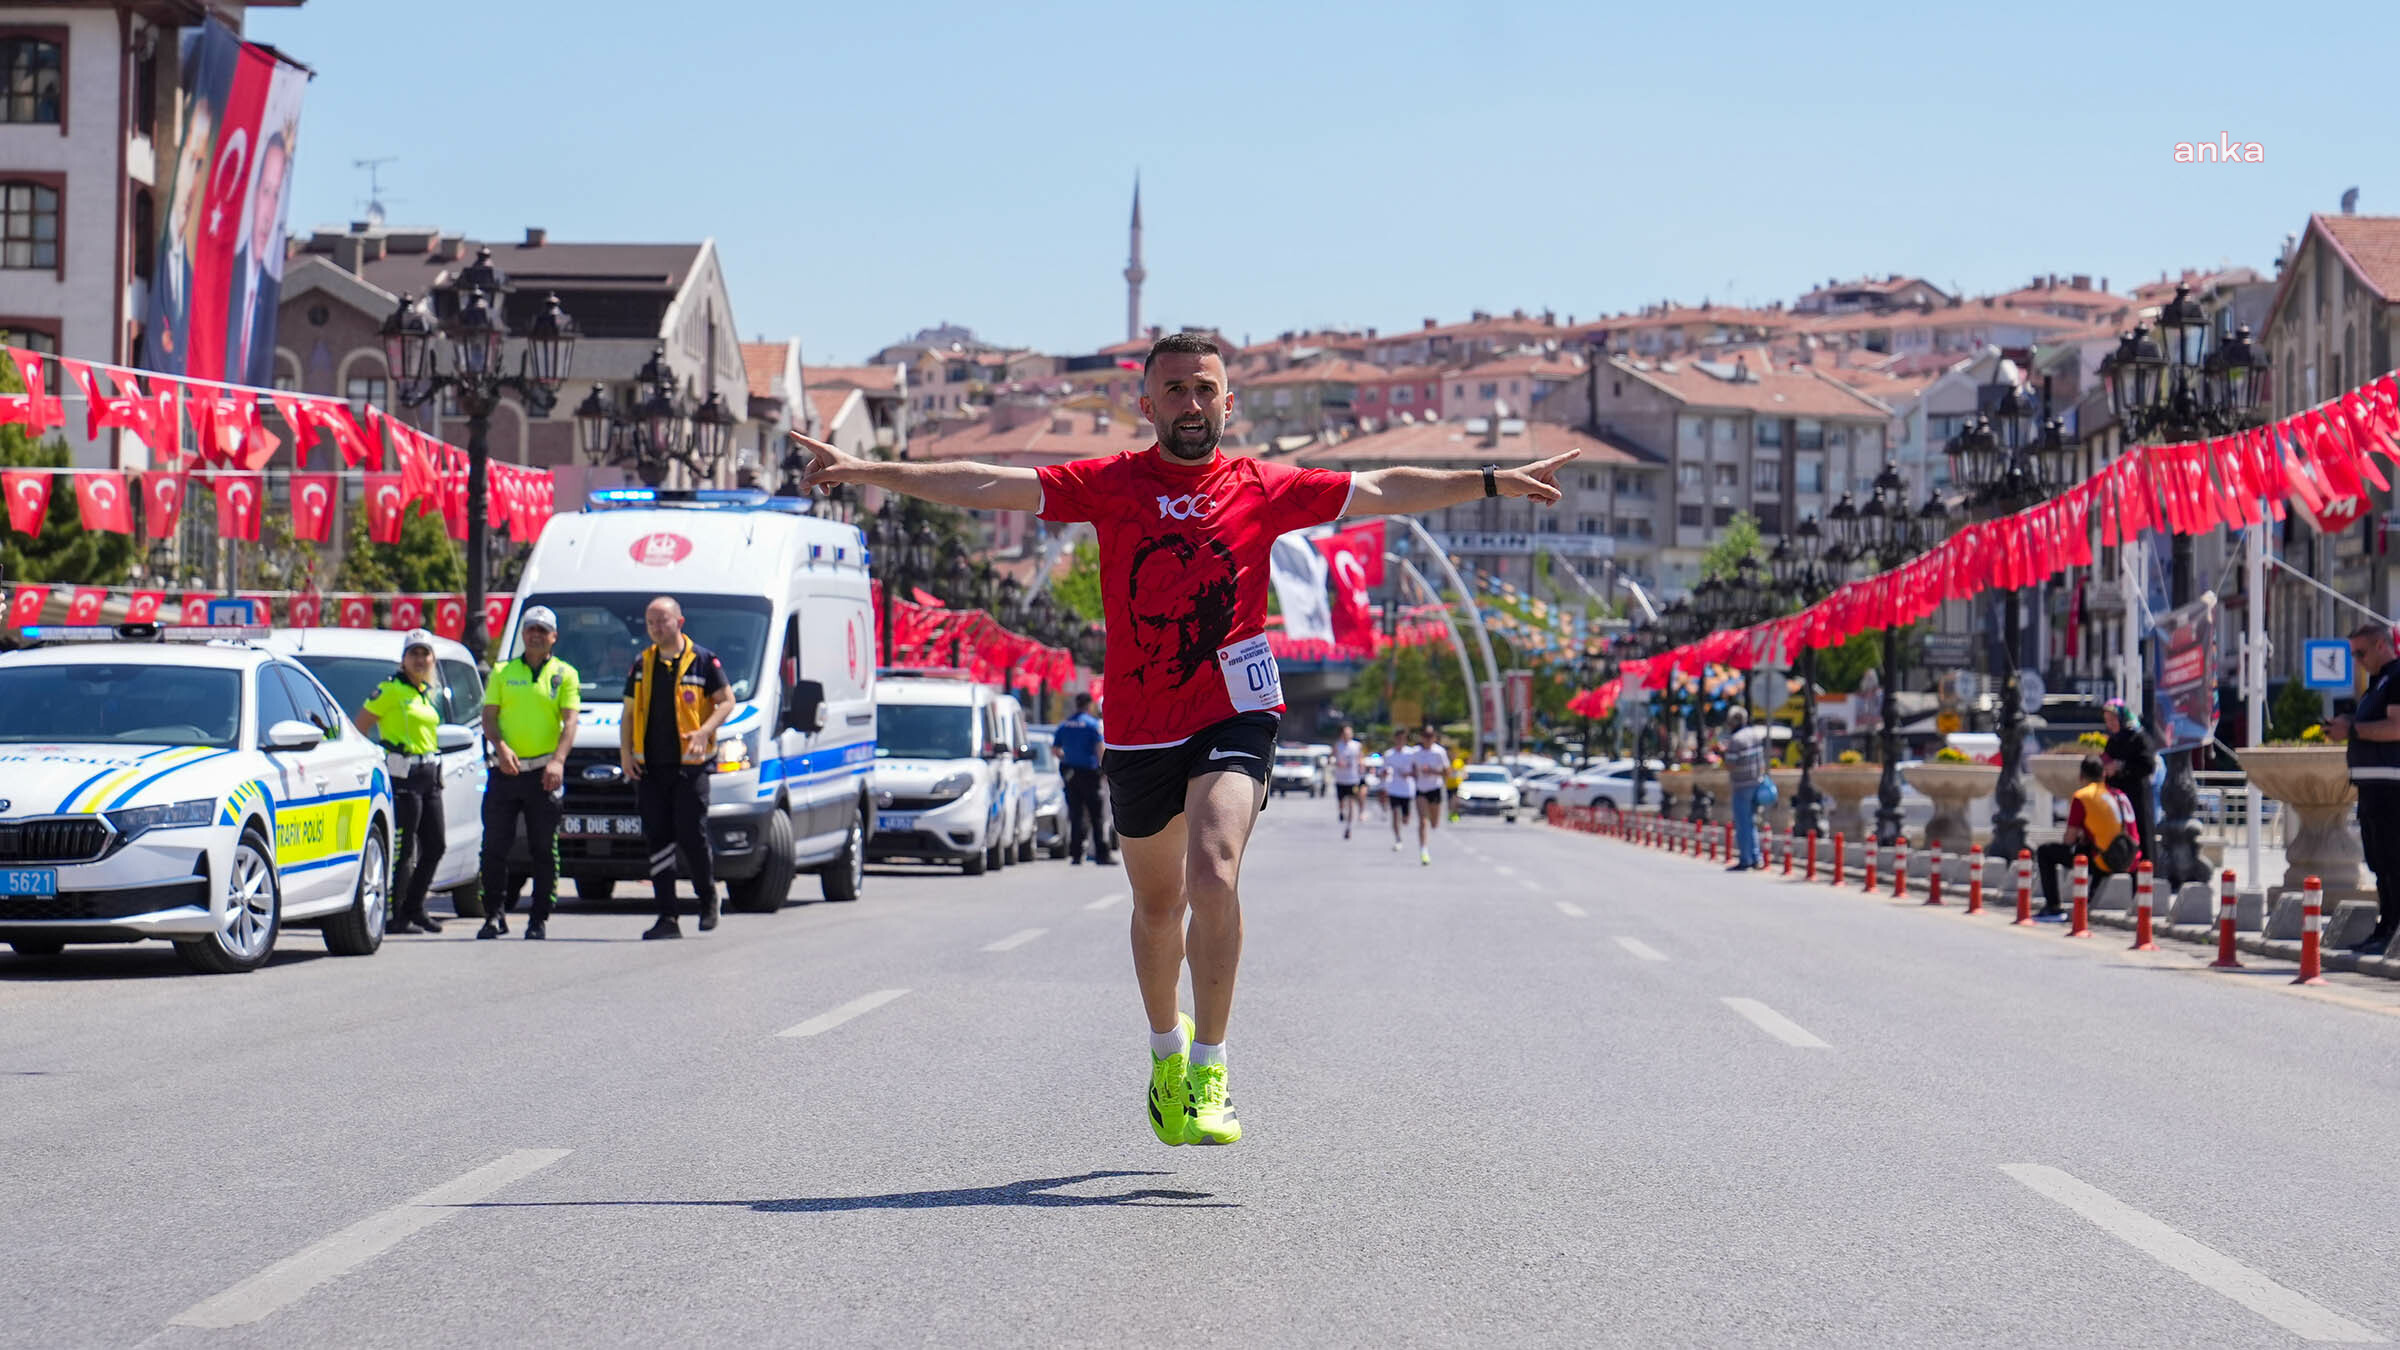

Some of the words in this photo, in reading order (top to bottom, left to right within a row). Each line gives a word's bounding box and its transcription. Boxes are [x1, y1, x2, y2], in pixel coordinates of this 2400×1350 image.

[277, 817, 302, 848] TRAFİK
[303, 811, 325, 844] POLİSİ
[564, 817, 581, 834] 06
[586, 817, 610, 834] DUE
[9, 872, 50, 893] 5621
